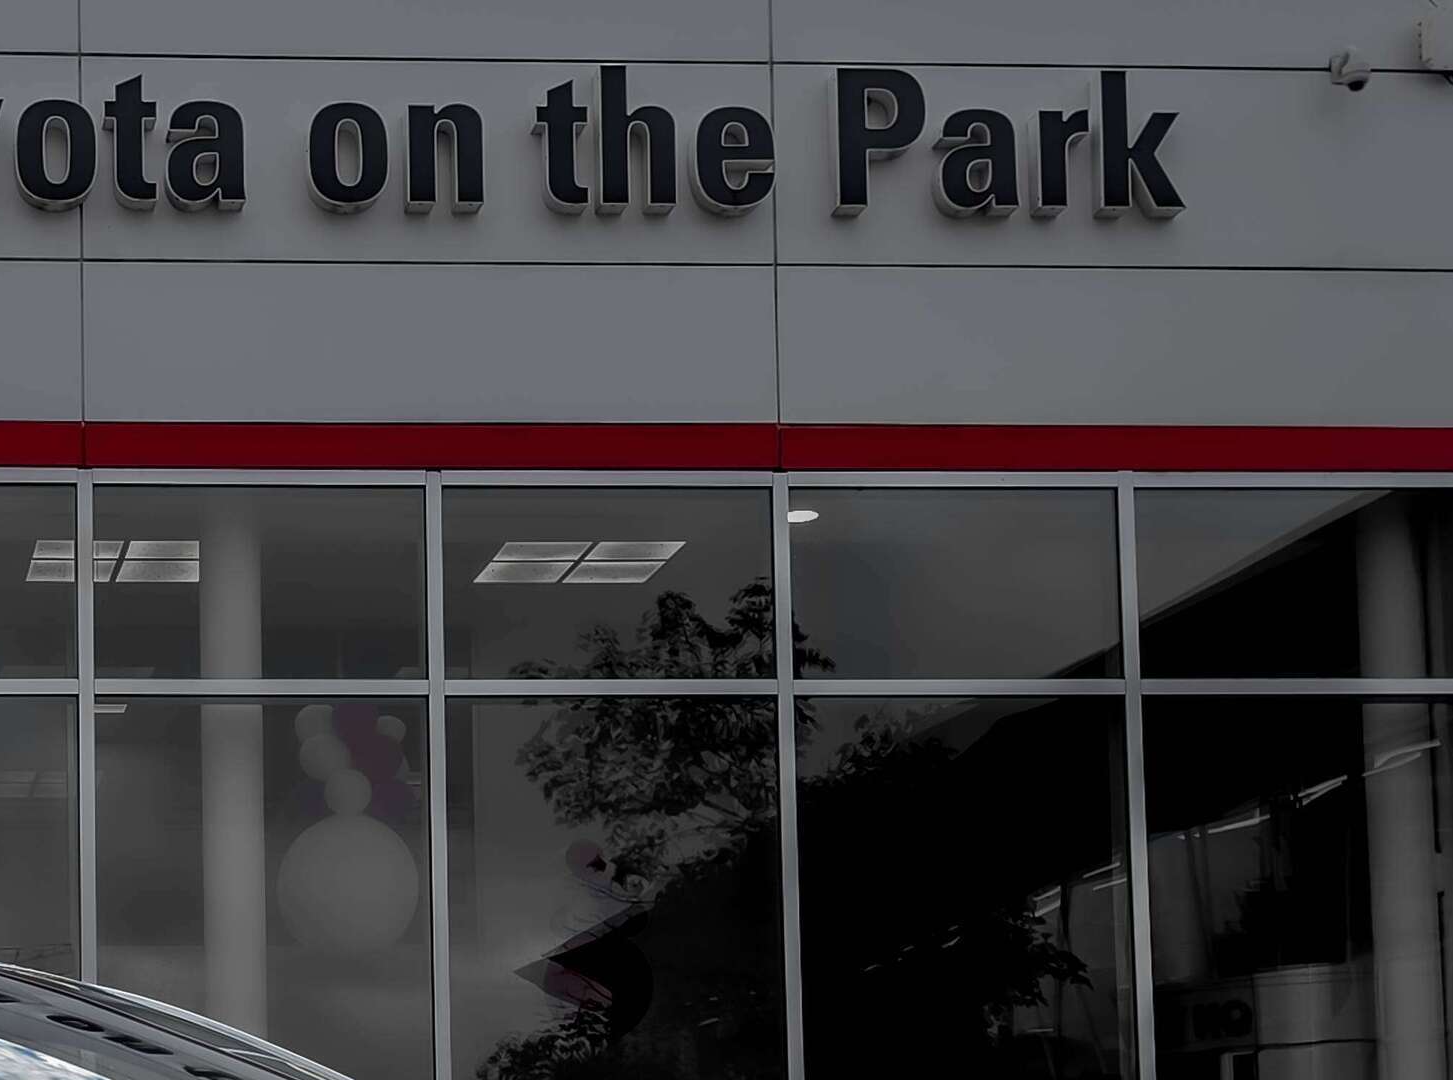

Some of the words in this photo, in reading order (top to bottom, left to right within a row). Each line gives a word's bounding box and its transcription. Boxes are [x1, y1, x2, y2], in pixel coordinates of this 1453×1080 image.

[308, 102, 484, 213] on
[532, 65, 775, 216] the
[831, 68, 1186, 218] Park
